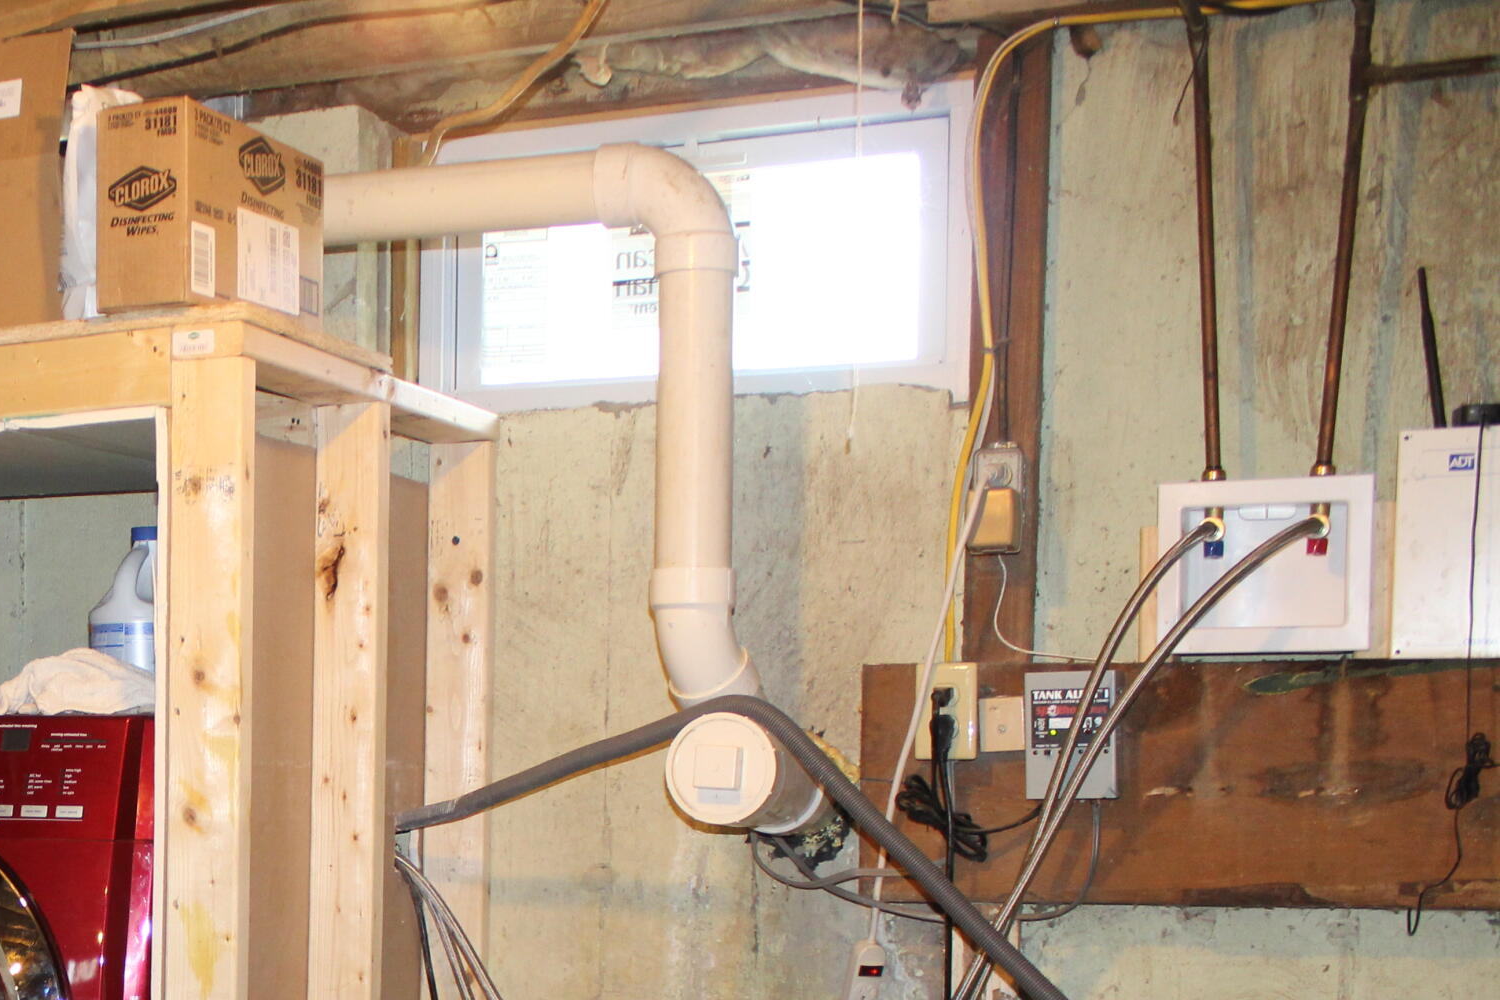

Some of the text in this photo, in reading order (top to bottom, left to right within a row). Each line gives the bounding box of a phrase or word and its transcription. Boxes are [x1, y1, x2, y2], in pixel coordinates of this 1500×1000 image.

[145, 115, 177, 130] 31181
[243, 151, 282, 178] CLOROX
[114, 168, 171, 207] CLOROX
[241, 191, 285, 221] DISINFECTING
[110, 212, 175, 228] DISINFECTING
[1450, 456, 1474, 469] ADT
[1032, 690, 1062, 700] TANK
